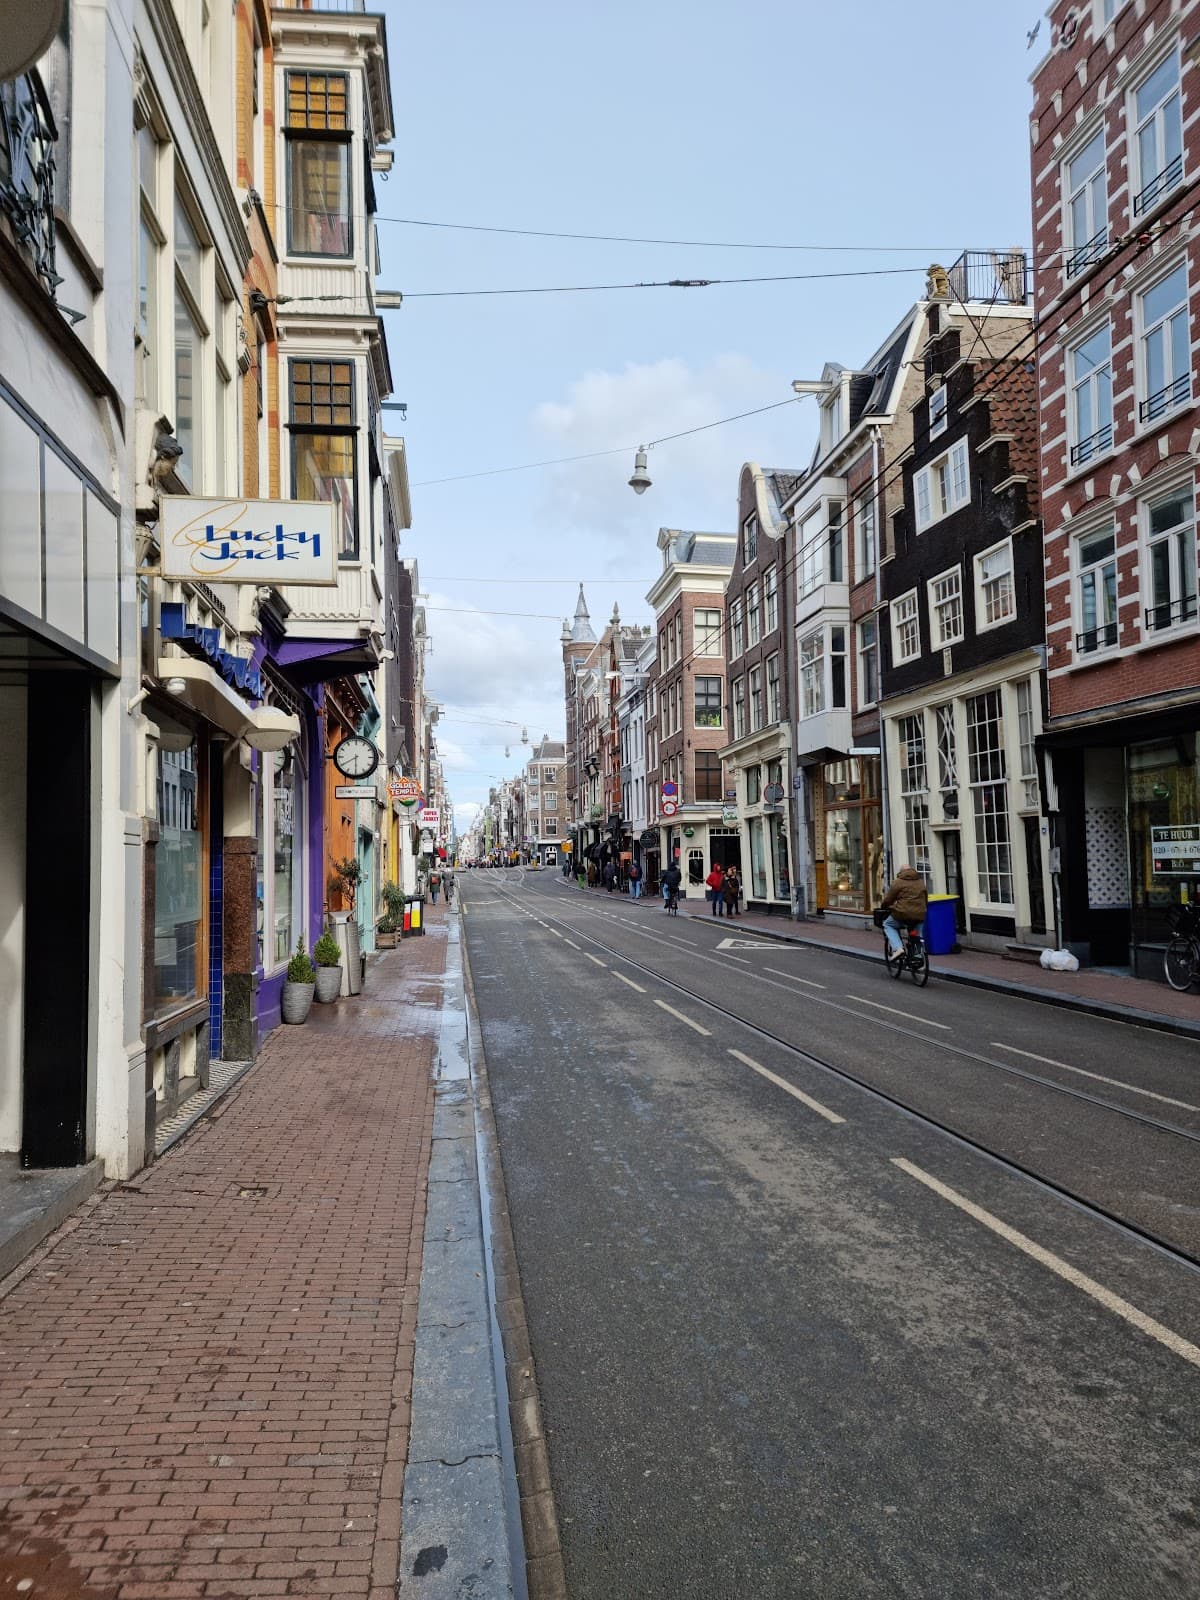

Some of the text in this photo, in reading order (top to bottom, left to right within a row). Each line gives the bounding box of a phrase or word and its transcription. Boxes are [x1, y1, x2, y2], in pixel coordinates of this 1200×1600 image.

[206, 524, 320, 557] Lucky
[200, 542, 299, 560] Jack
[1159, 829, 1193, 840] TE HUUR
